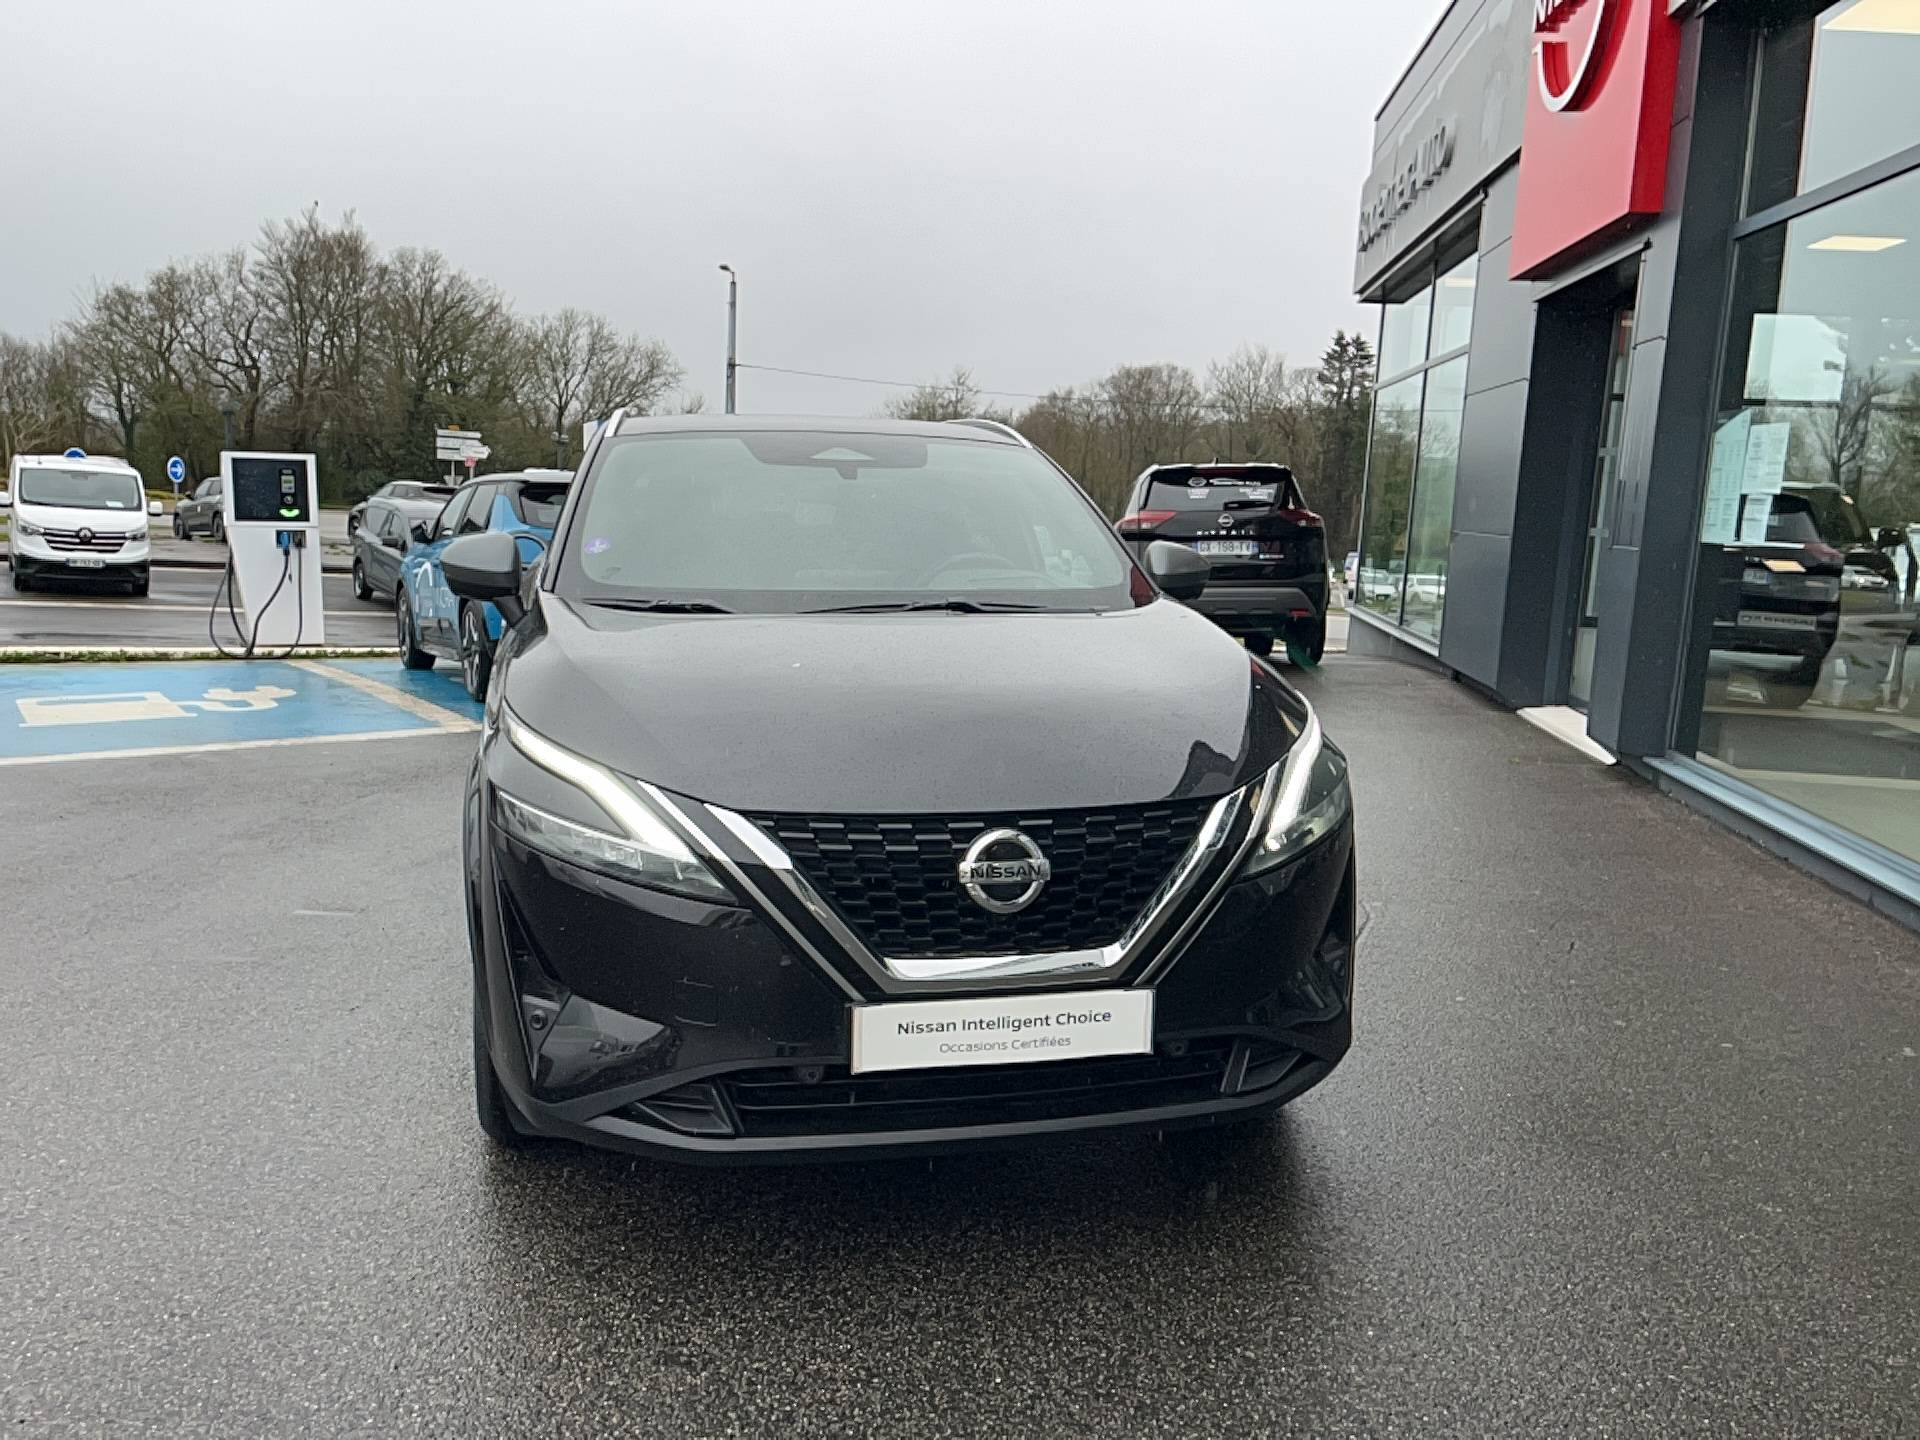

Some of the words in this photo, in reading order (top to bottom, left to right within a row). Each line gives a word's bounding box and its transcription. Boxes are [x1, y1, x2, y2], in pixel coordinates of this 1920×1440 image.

[970, 863, 1041, 880] NISSAN
[897, 1020, 957, 1035] Nissan
[961, 1013, 1052, 1032] Intelligent
[1055, 1010, 1112, 1026] Choice
[938, 1041, 1009, 1054] Occasions
[1010, 1036, 1072, 1051] Certifiées
